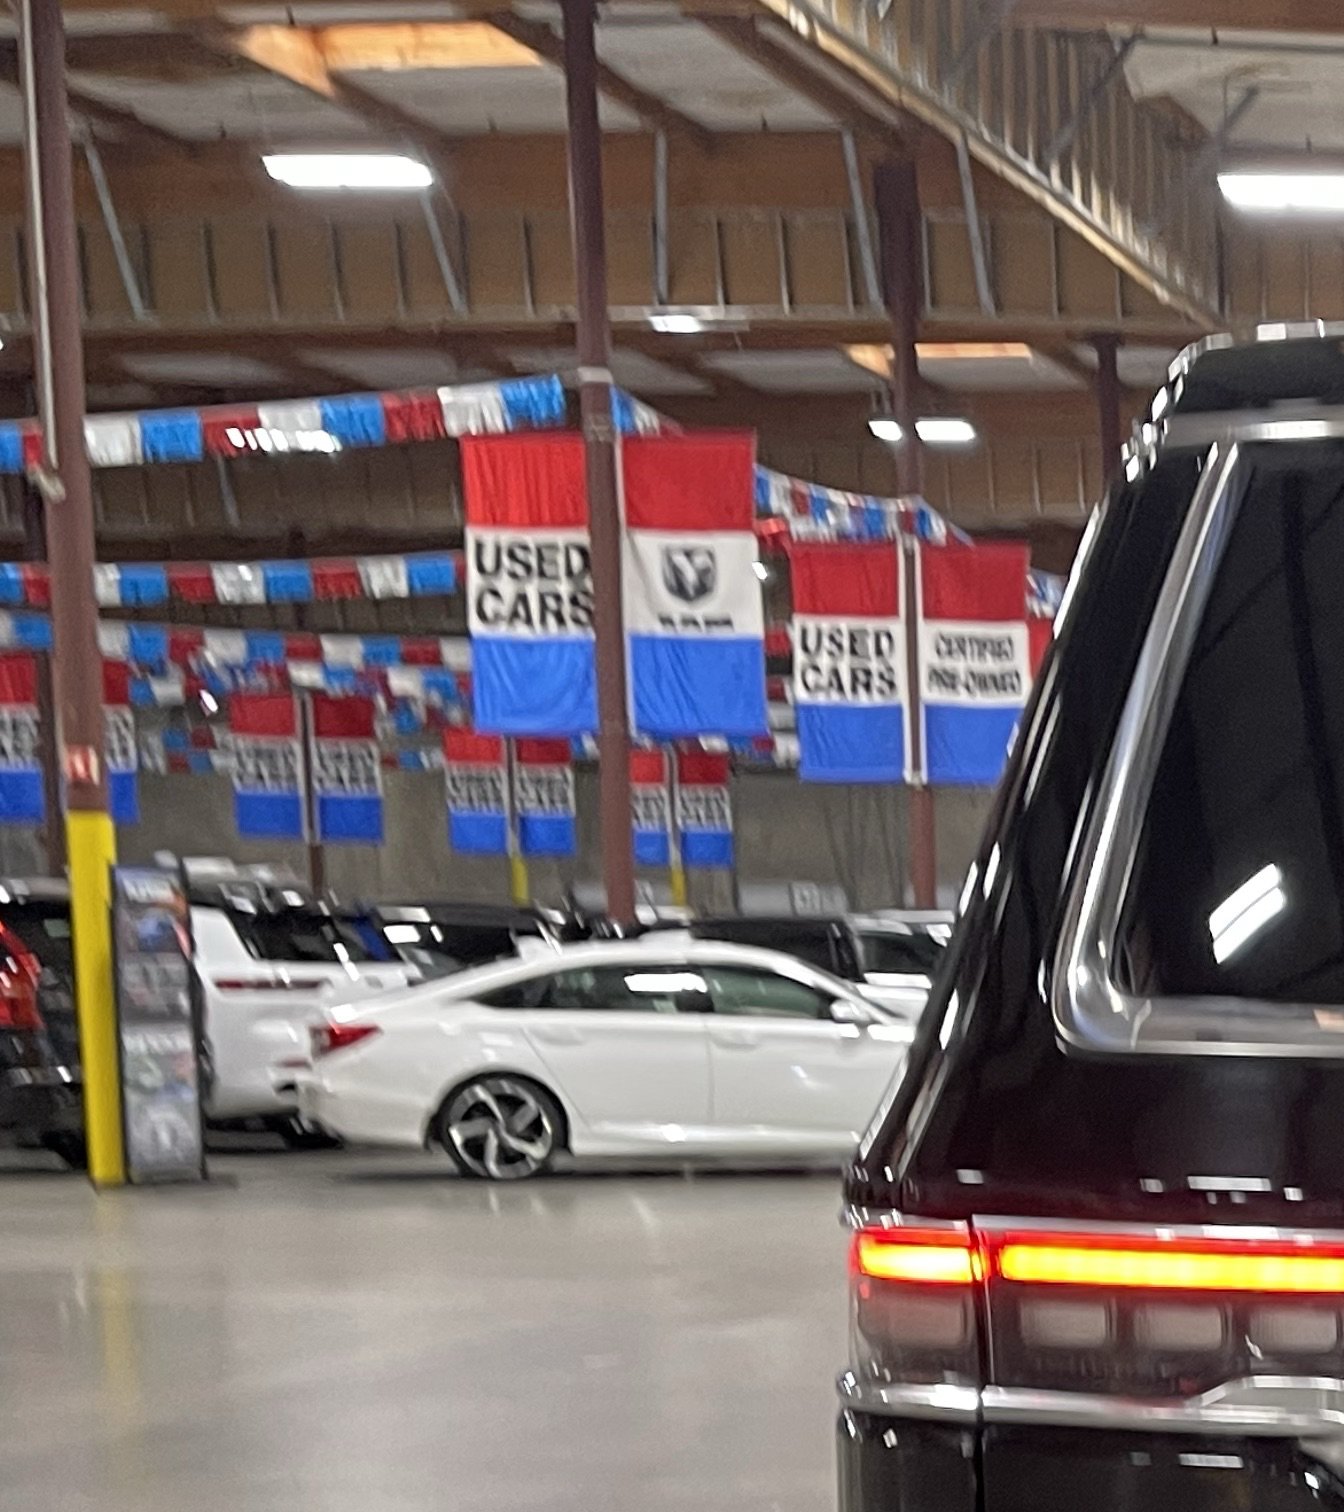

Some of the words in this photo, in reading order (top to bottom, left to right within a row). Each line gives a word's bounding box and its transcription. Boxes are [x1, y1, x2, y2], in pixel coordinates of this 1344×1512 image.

[475, 540, 591, 580] USED
[476, 588, 595, 628] CARS
[801, 625, 895, 660] USED
[801, 664, 898, 696] CARS
